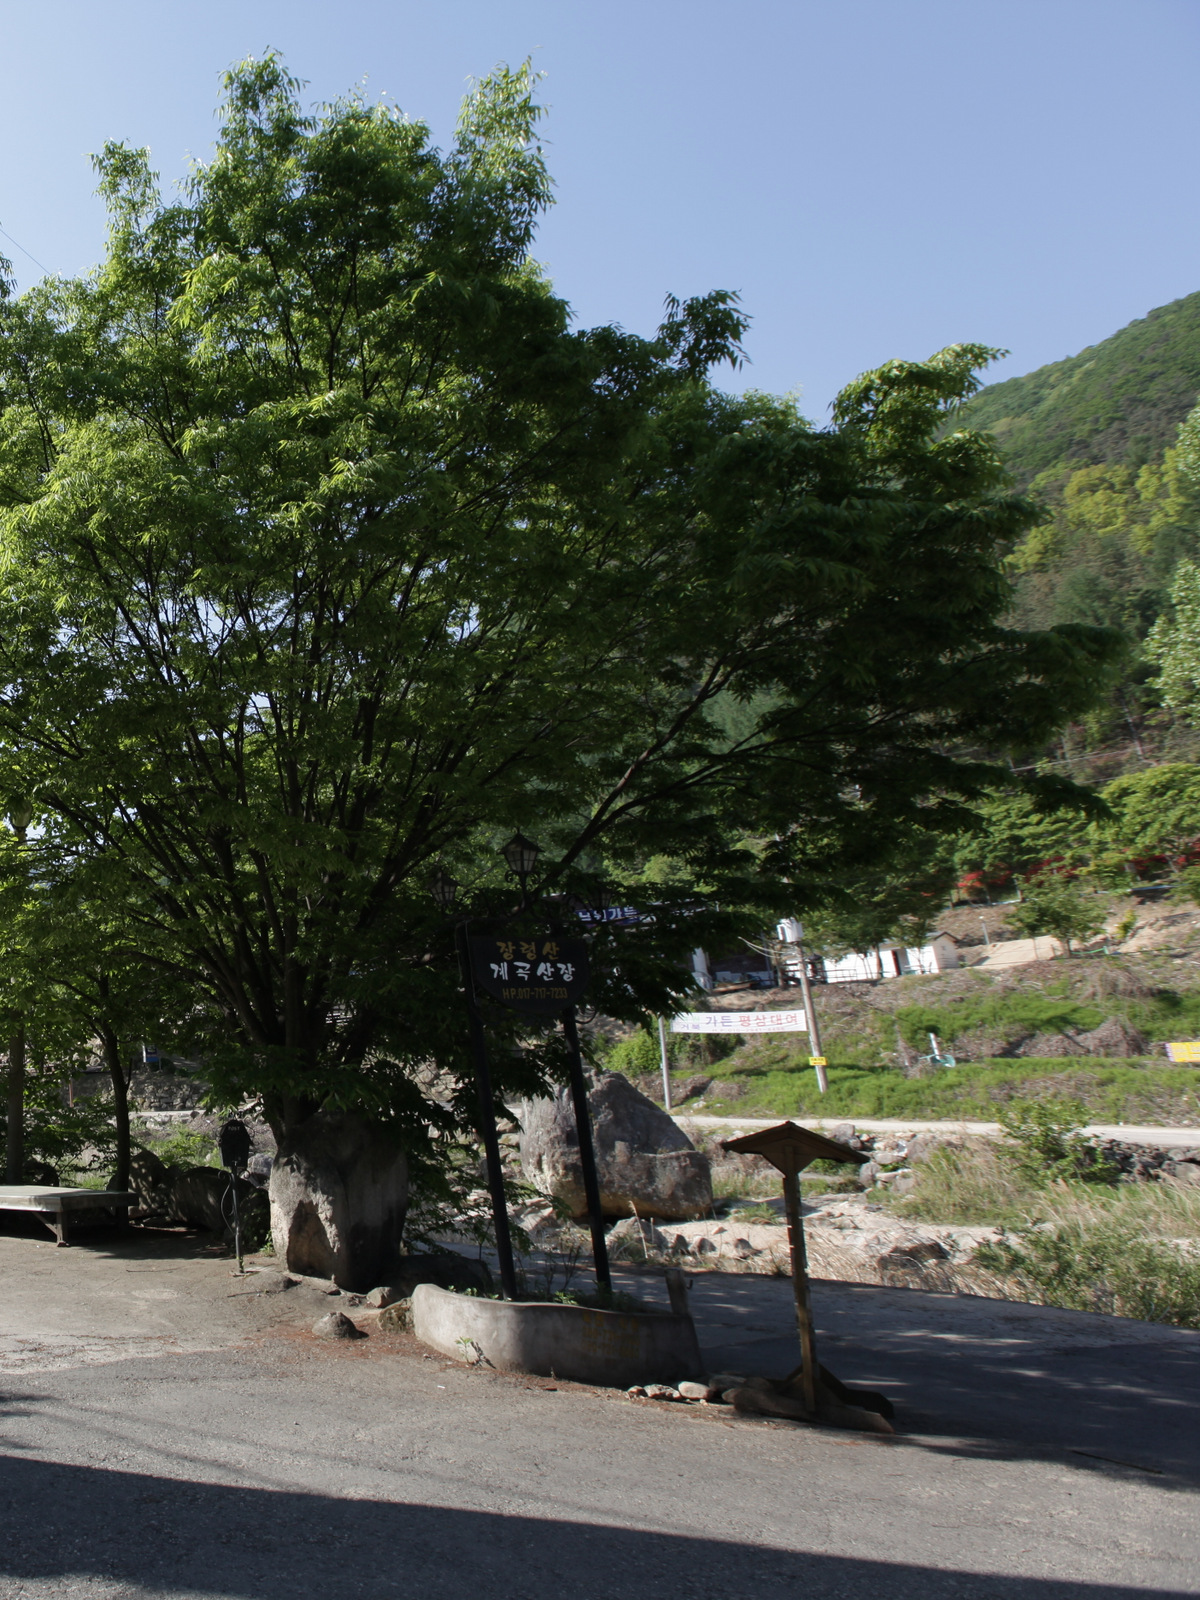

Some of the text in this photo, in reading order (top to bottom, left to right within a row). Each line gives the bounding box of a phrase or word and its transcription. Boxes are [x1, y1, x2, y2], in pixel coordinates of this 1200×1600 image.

[495, 941, 561, 961] 장령산
[489, 961, 576, 982] 계곡산장
[705, 1015, 733, 1027] 가든
